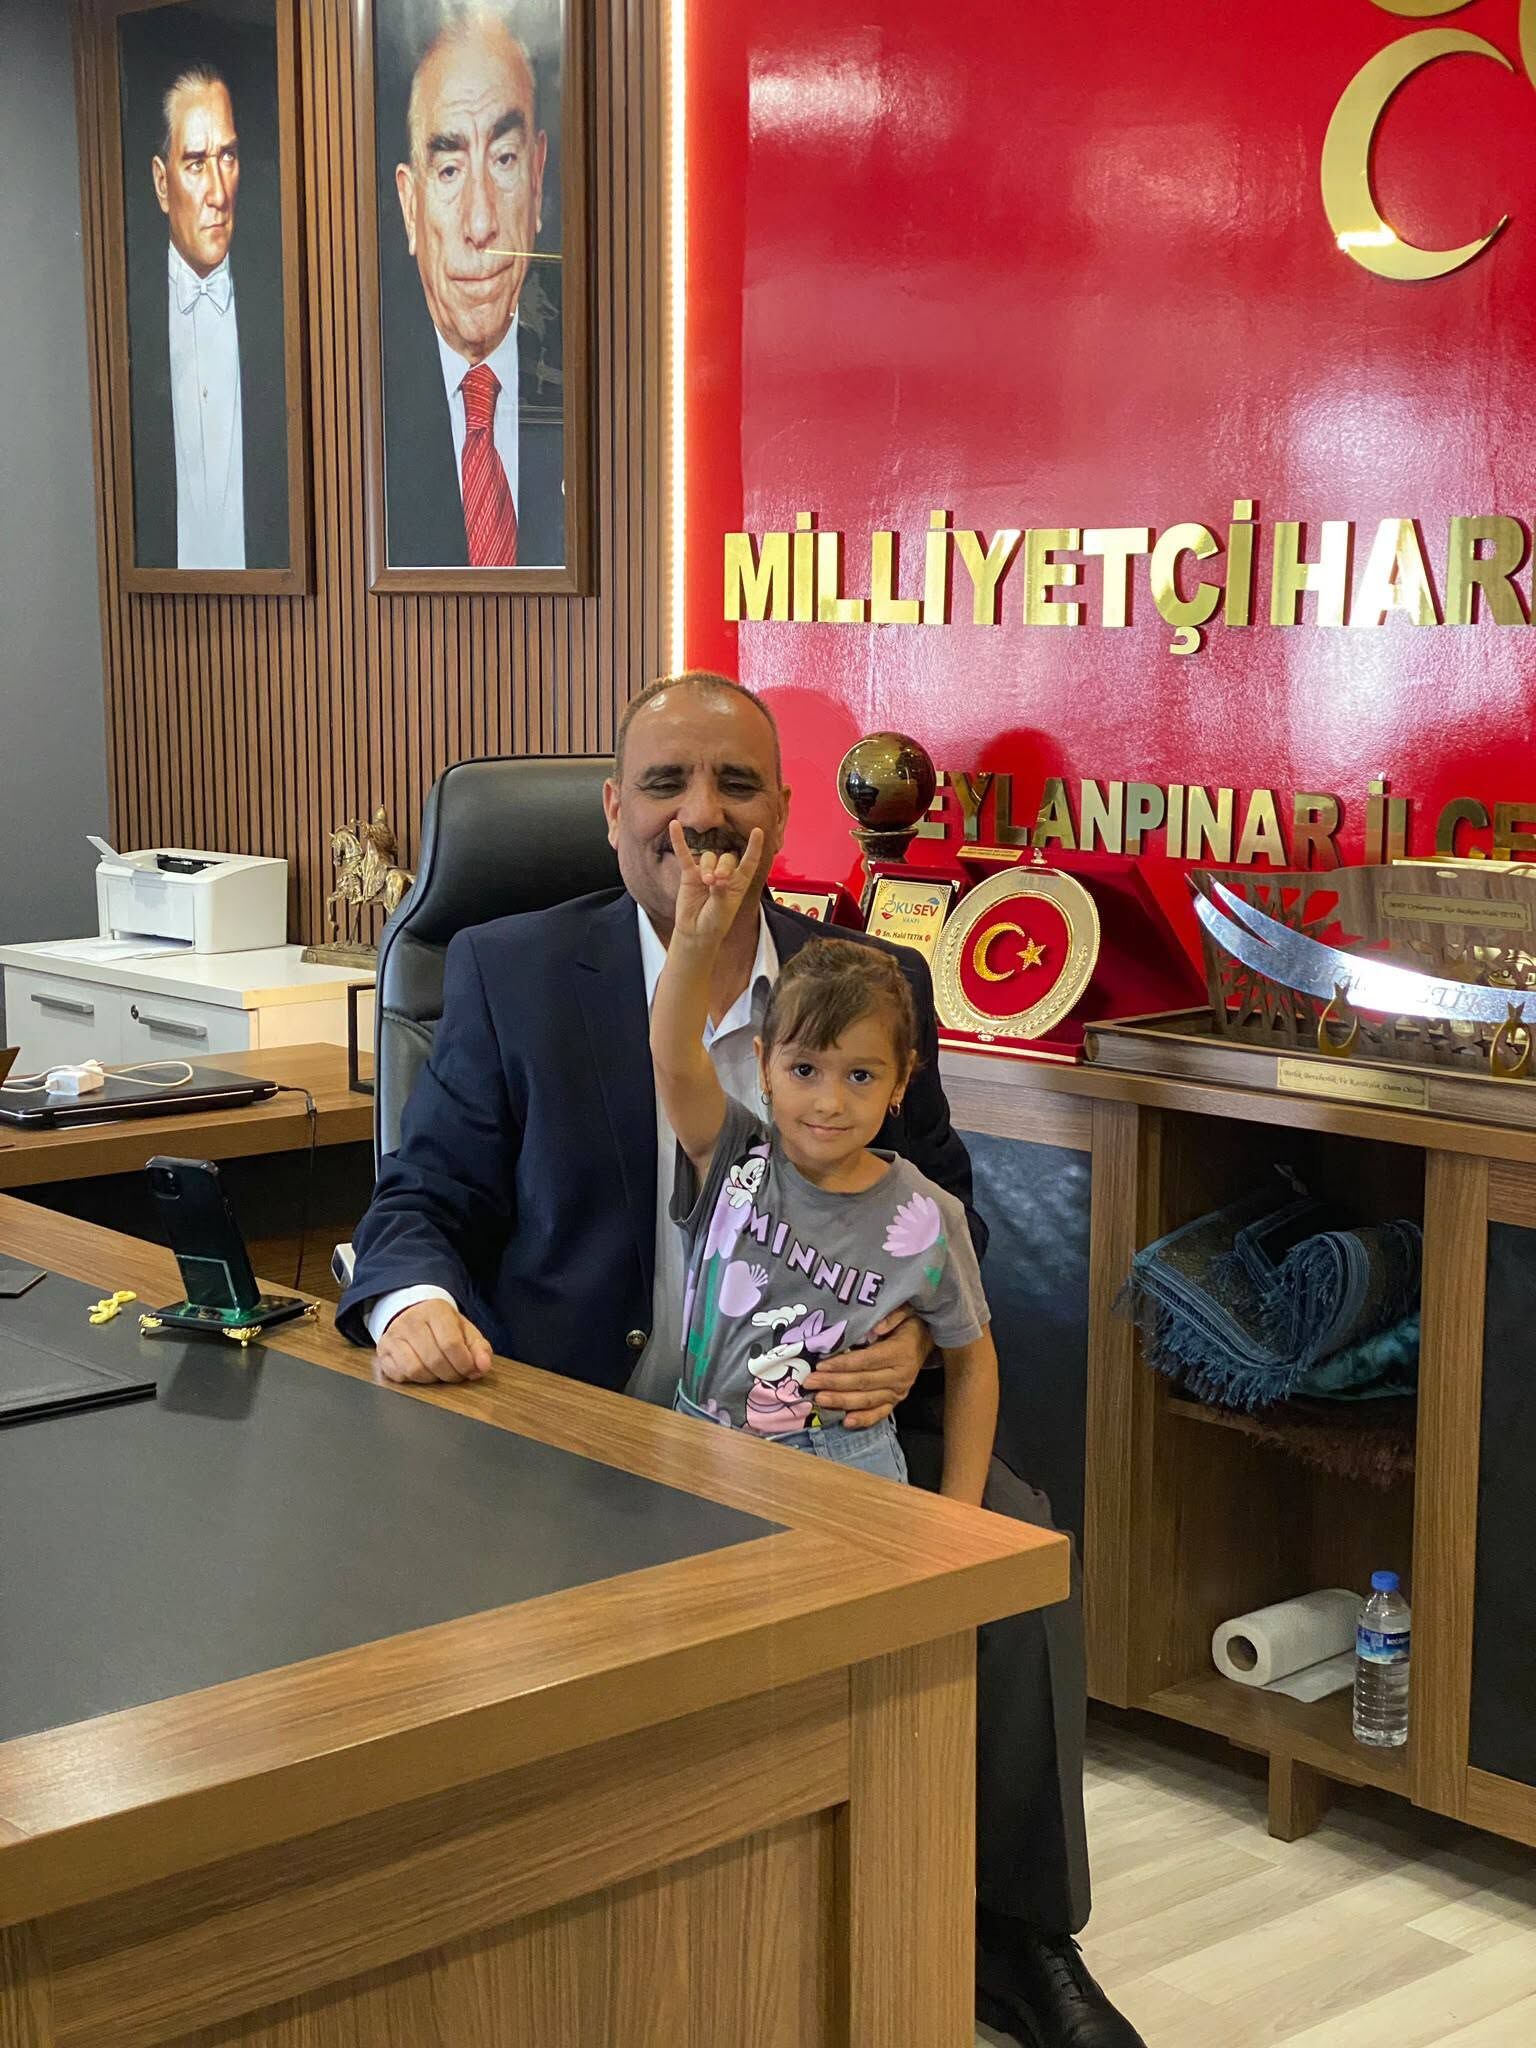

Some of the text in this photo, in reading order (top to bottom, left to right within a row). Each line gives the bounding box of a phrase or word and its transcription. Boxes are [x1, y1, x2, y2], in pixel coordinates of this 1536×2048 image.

[724, 499, 1536, 655] MİLLİYETÇİ HAR
[912, 771, 1341, 869] EYLANPINAR
[743, 1202, 885, 1307] MINNIE
